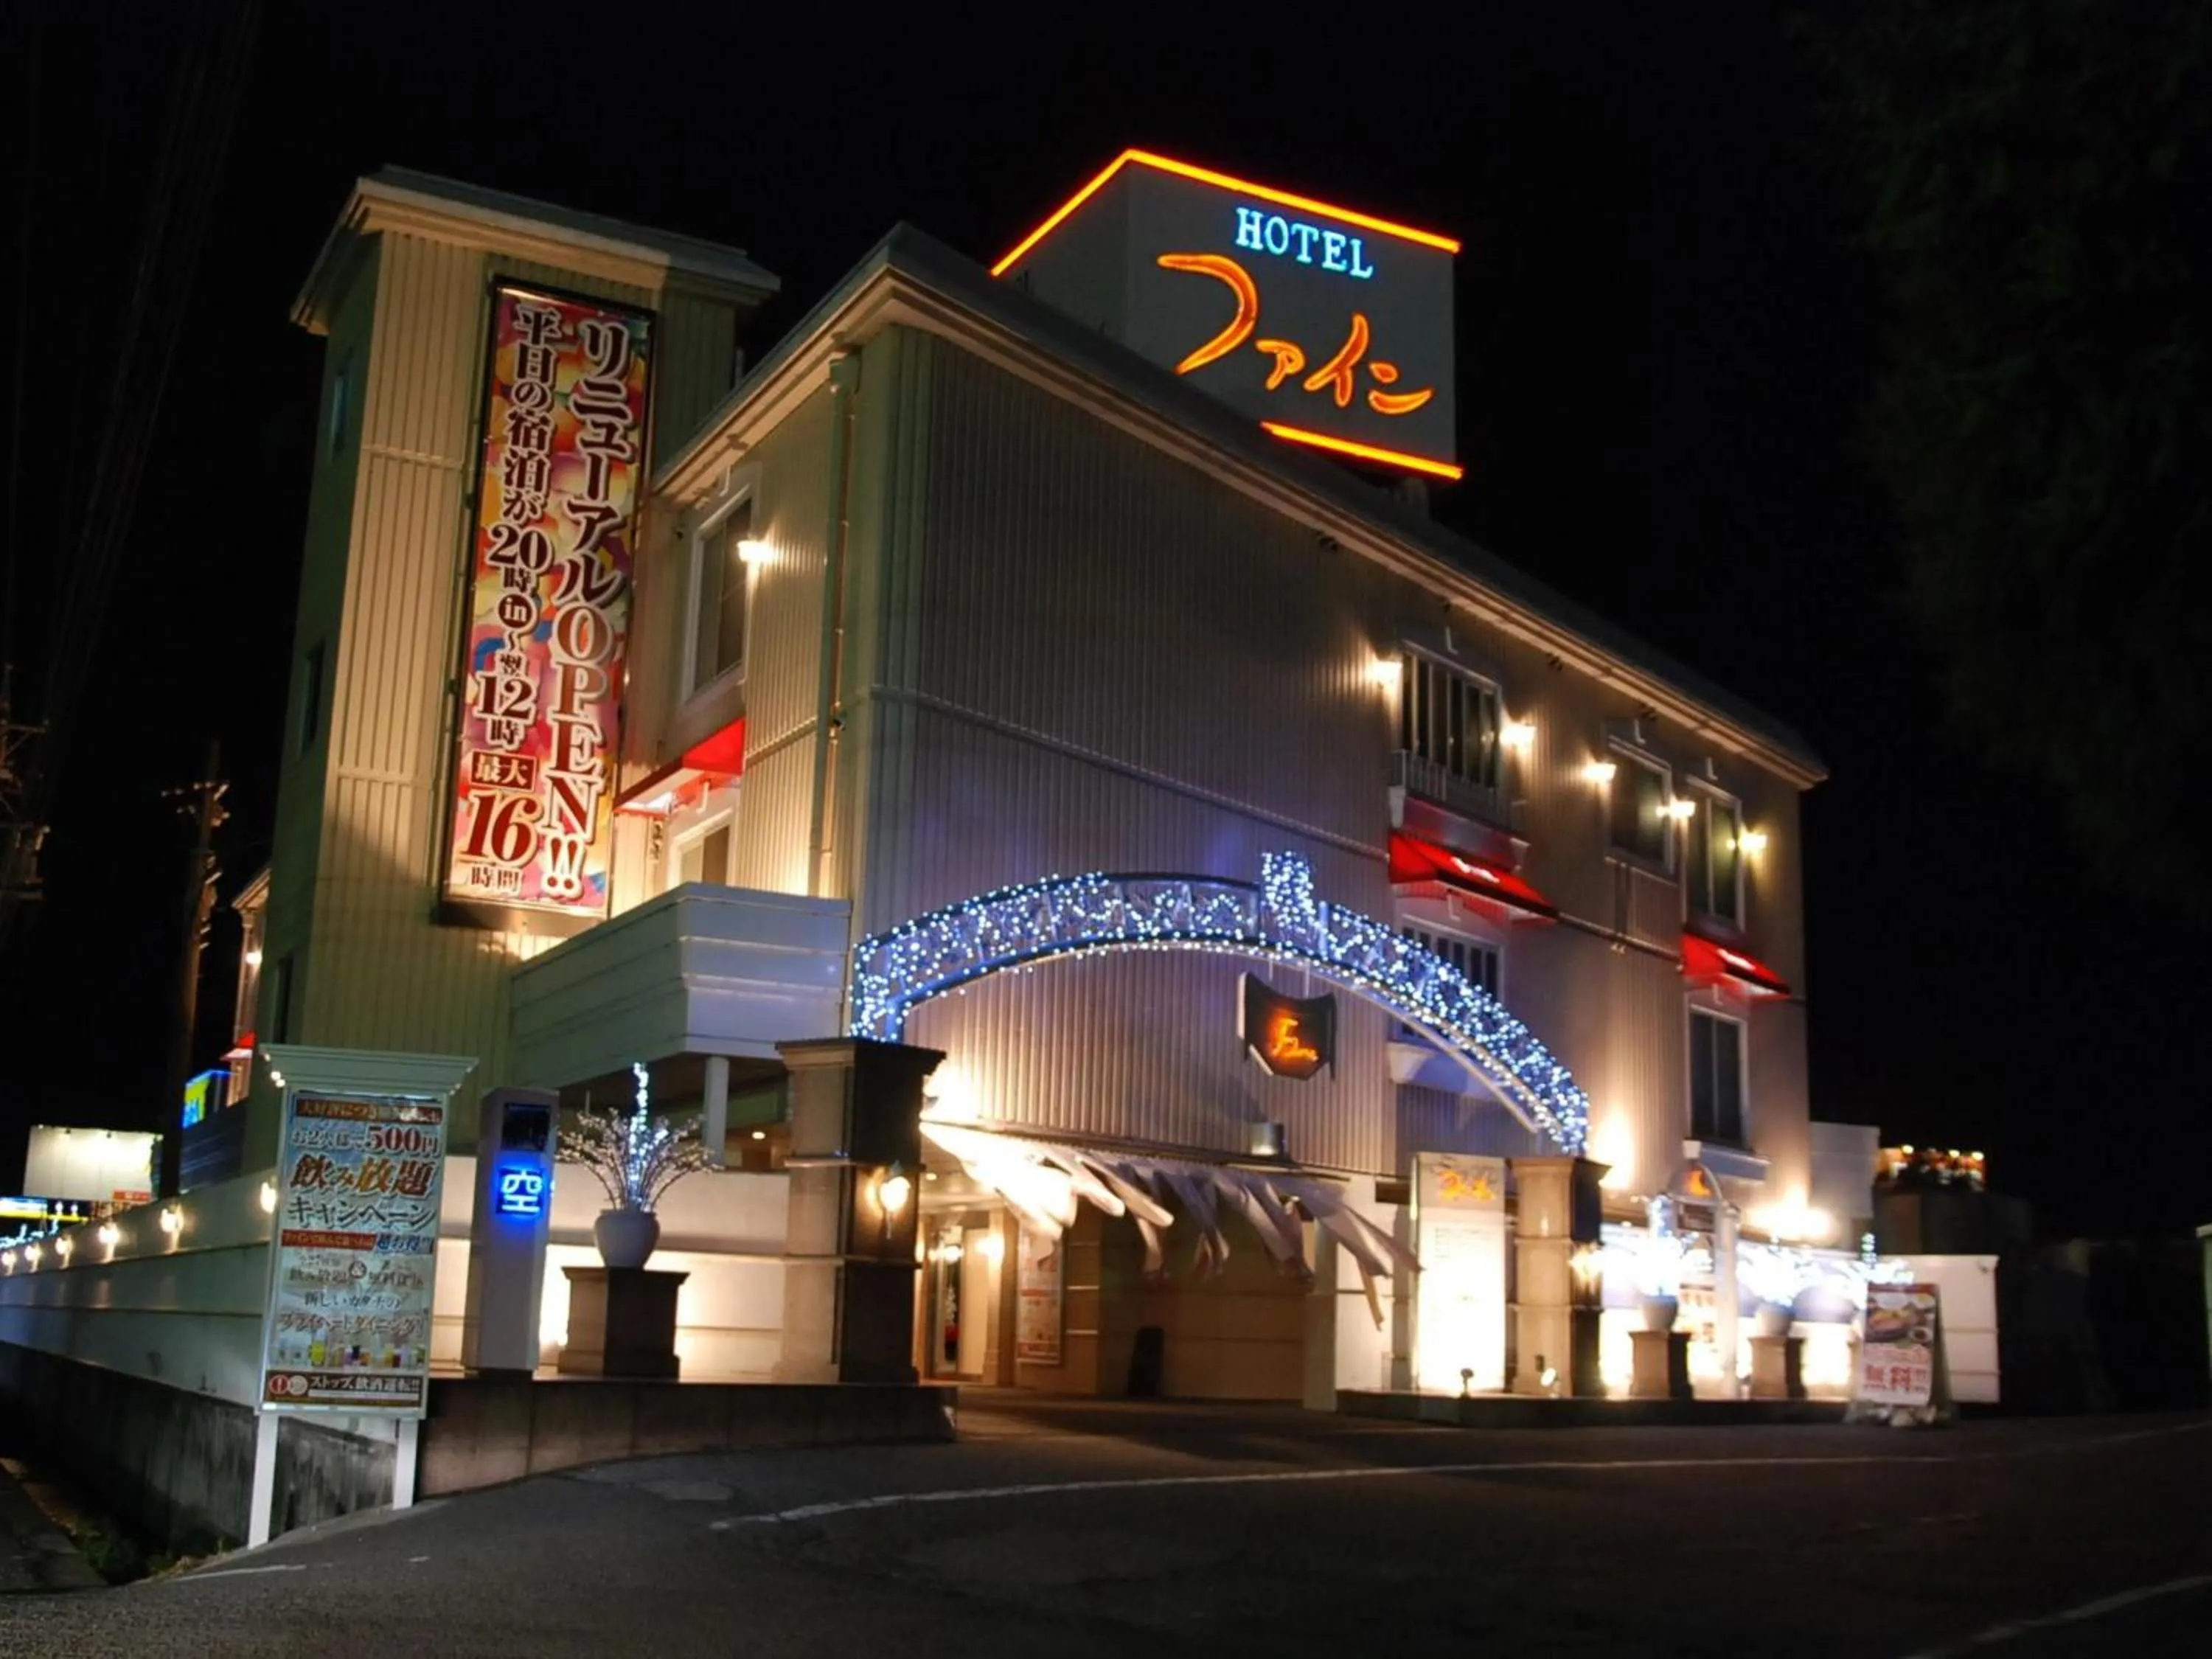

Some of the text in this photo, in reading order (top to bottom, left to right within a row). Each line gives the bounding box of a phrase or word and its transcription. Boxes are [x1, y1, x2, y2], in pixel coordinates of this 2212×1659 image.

[1235, 207, 1374, 279] HOTEL
[1156, 253, 1433, 415] ファイン
[290, 1154, 437, 1197] 飲み放題
[501, 1169, 543, 1213] 空
